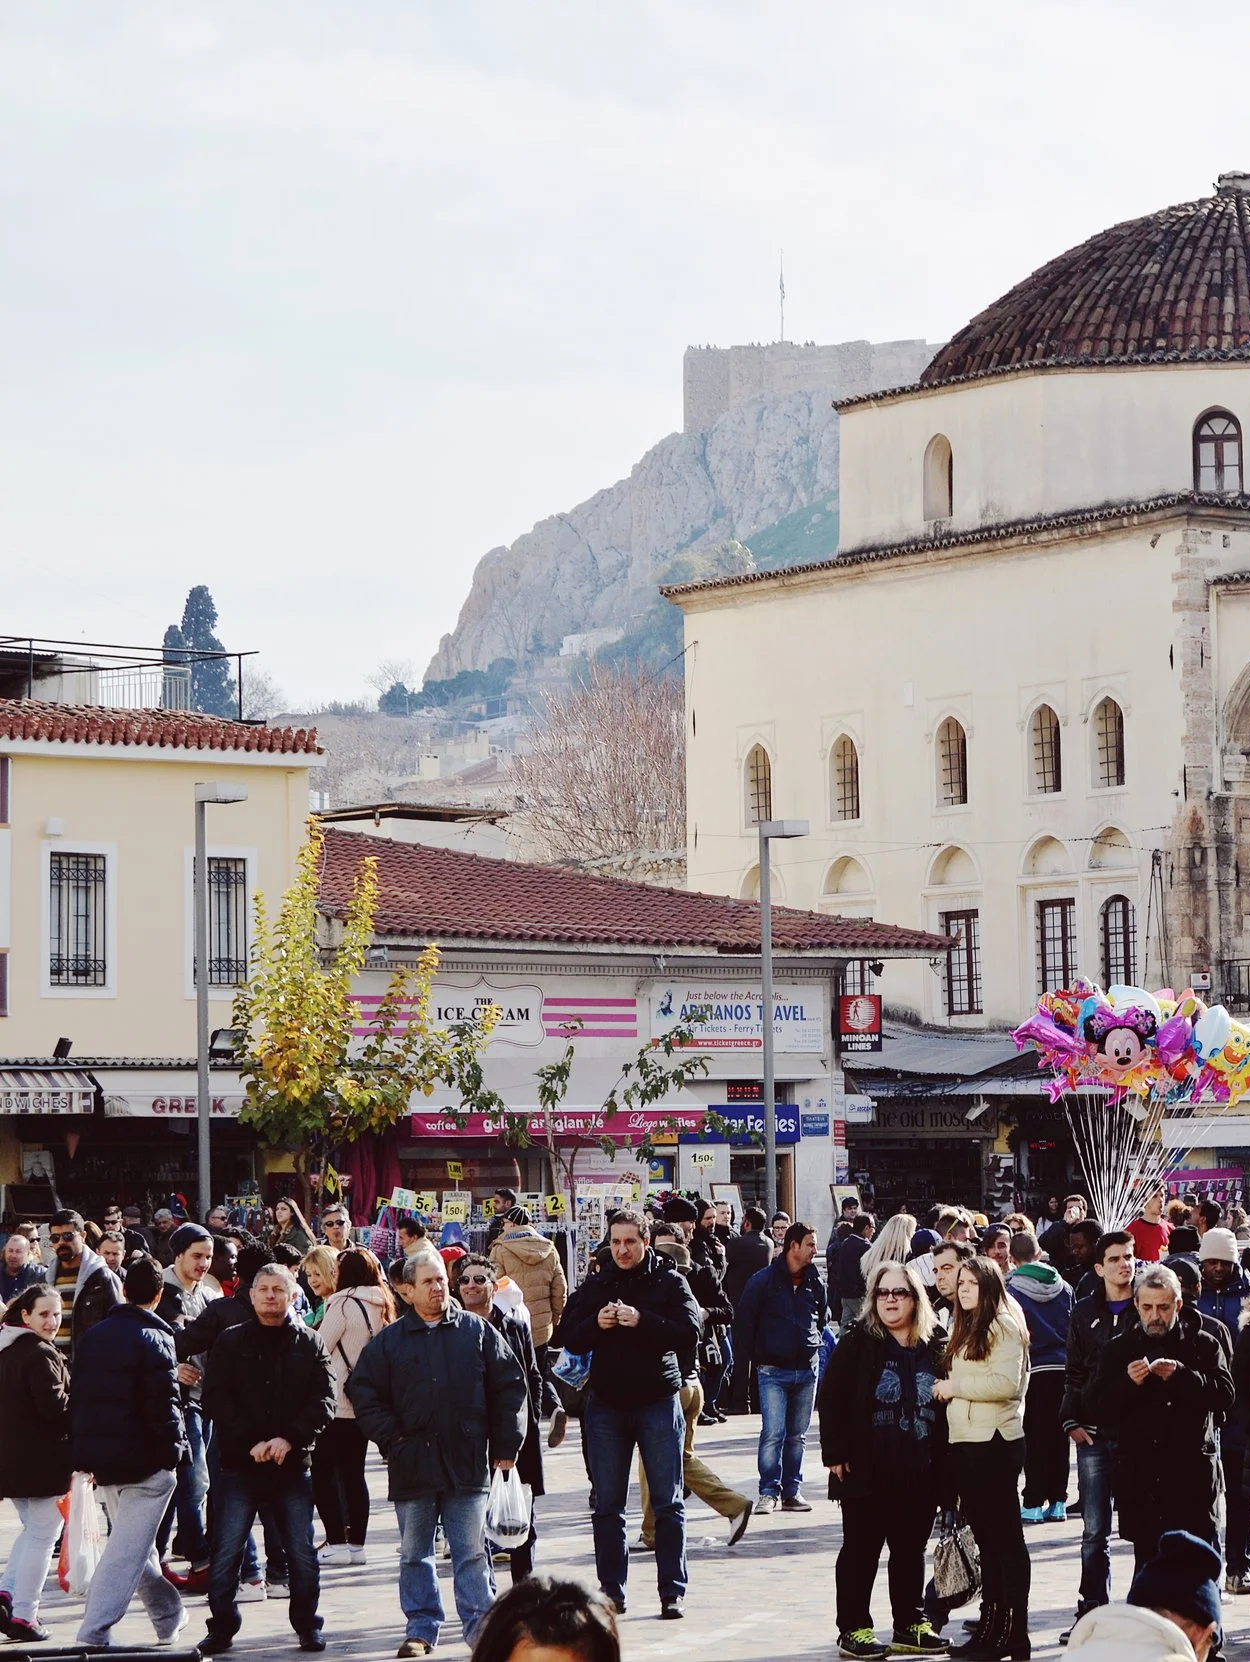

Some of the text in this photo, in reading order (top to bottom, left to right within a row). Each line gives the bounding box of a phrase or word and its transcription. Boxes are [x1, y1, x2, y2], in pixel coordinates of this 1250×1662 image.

[474, 998, 493, 1006] THE
[686, 991, 789, 1002] Just below the Acrolis...
[437, 1007, 465, 1020] ICE
[757, 1005, 807, 1021] TAVEL
[700, 1025, 727, 1033] Tickets
[734, 1025, 753, 1034] Ferry
[755, 1026, 782, 1034] Tits
[698, 1040, 759, 1048] www.ticketgreece.gr
[841, 1034, 879, 1042] MINOAN
[847, 1042, 872, 1050] LINES
[152, 1098, 226, 1114] GREK
[425, 1114, 604, 1132] coffee gel arigianle
[628, 1112, 658, 1133] Liege
[659, 1116, 696, 1128] wfles
[747, 1115, 795, 1133] Feies
[901, 1109, 925, 1128] old
